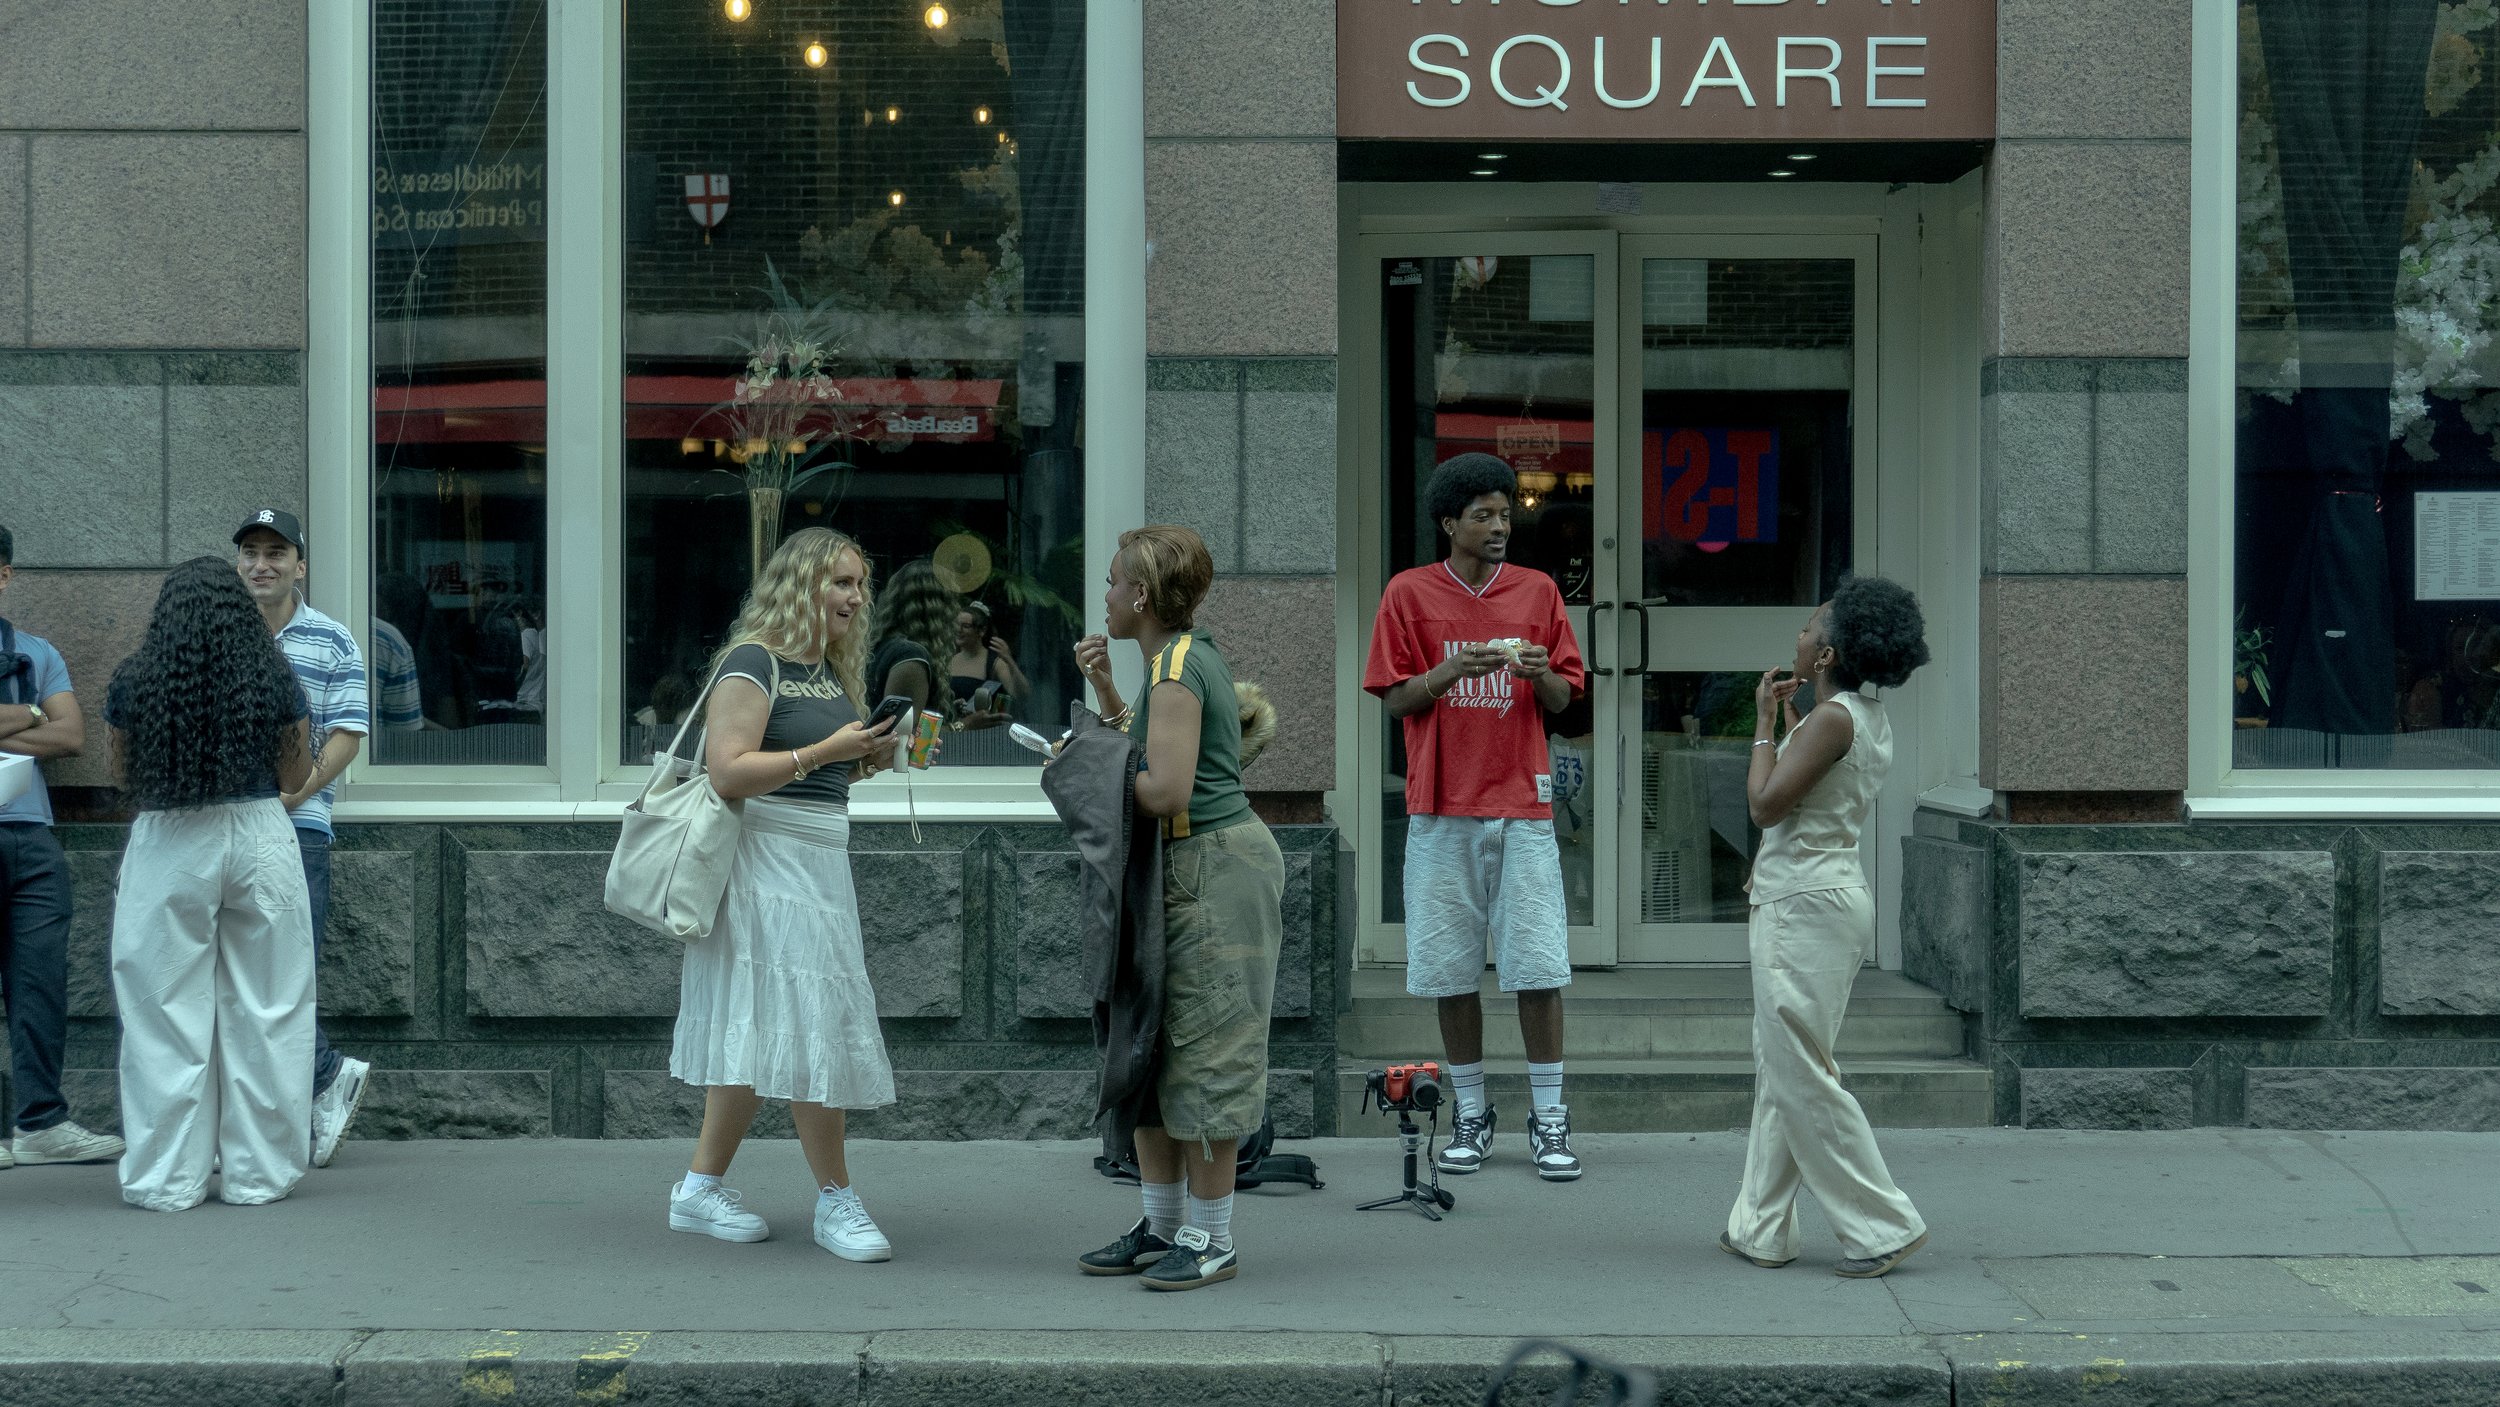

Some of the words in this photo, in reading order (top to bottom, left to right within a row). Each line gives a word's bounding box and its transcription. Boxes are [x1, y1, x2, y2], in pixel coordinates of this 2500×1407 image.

[1405, 33, 1928, 112] SQUARE
[1502, 435, 1554, 451] OPEN
[776, 676, 844, 701] ench.
[1447, 670, 1513, 698] ACING
